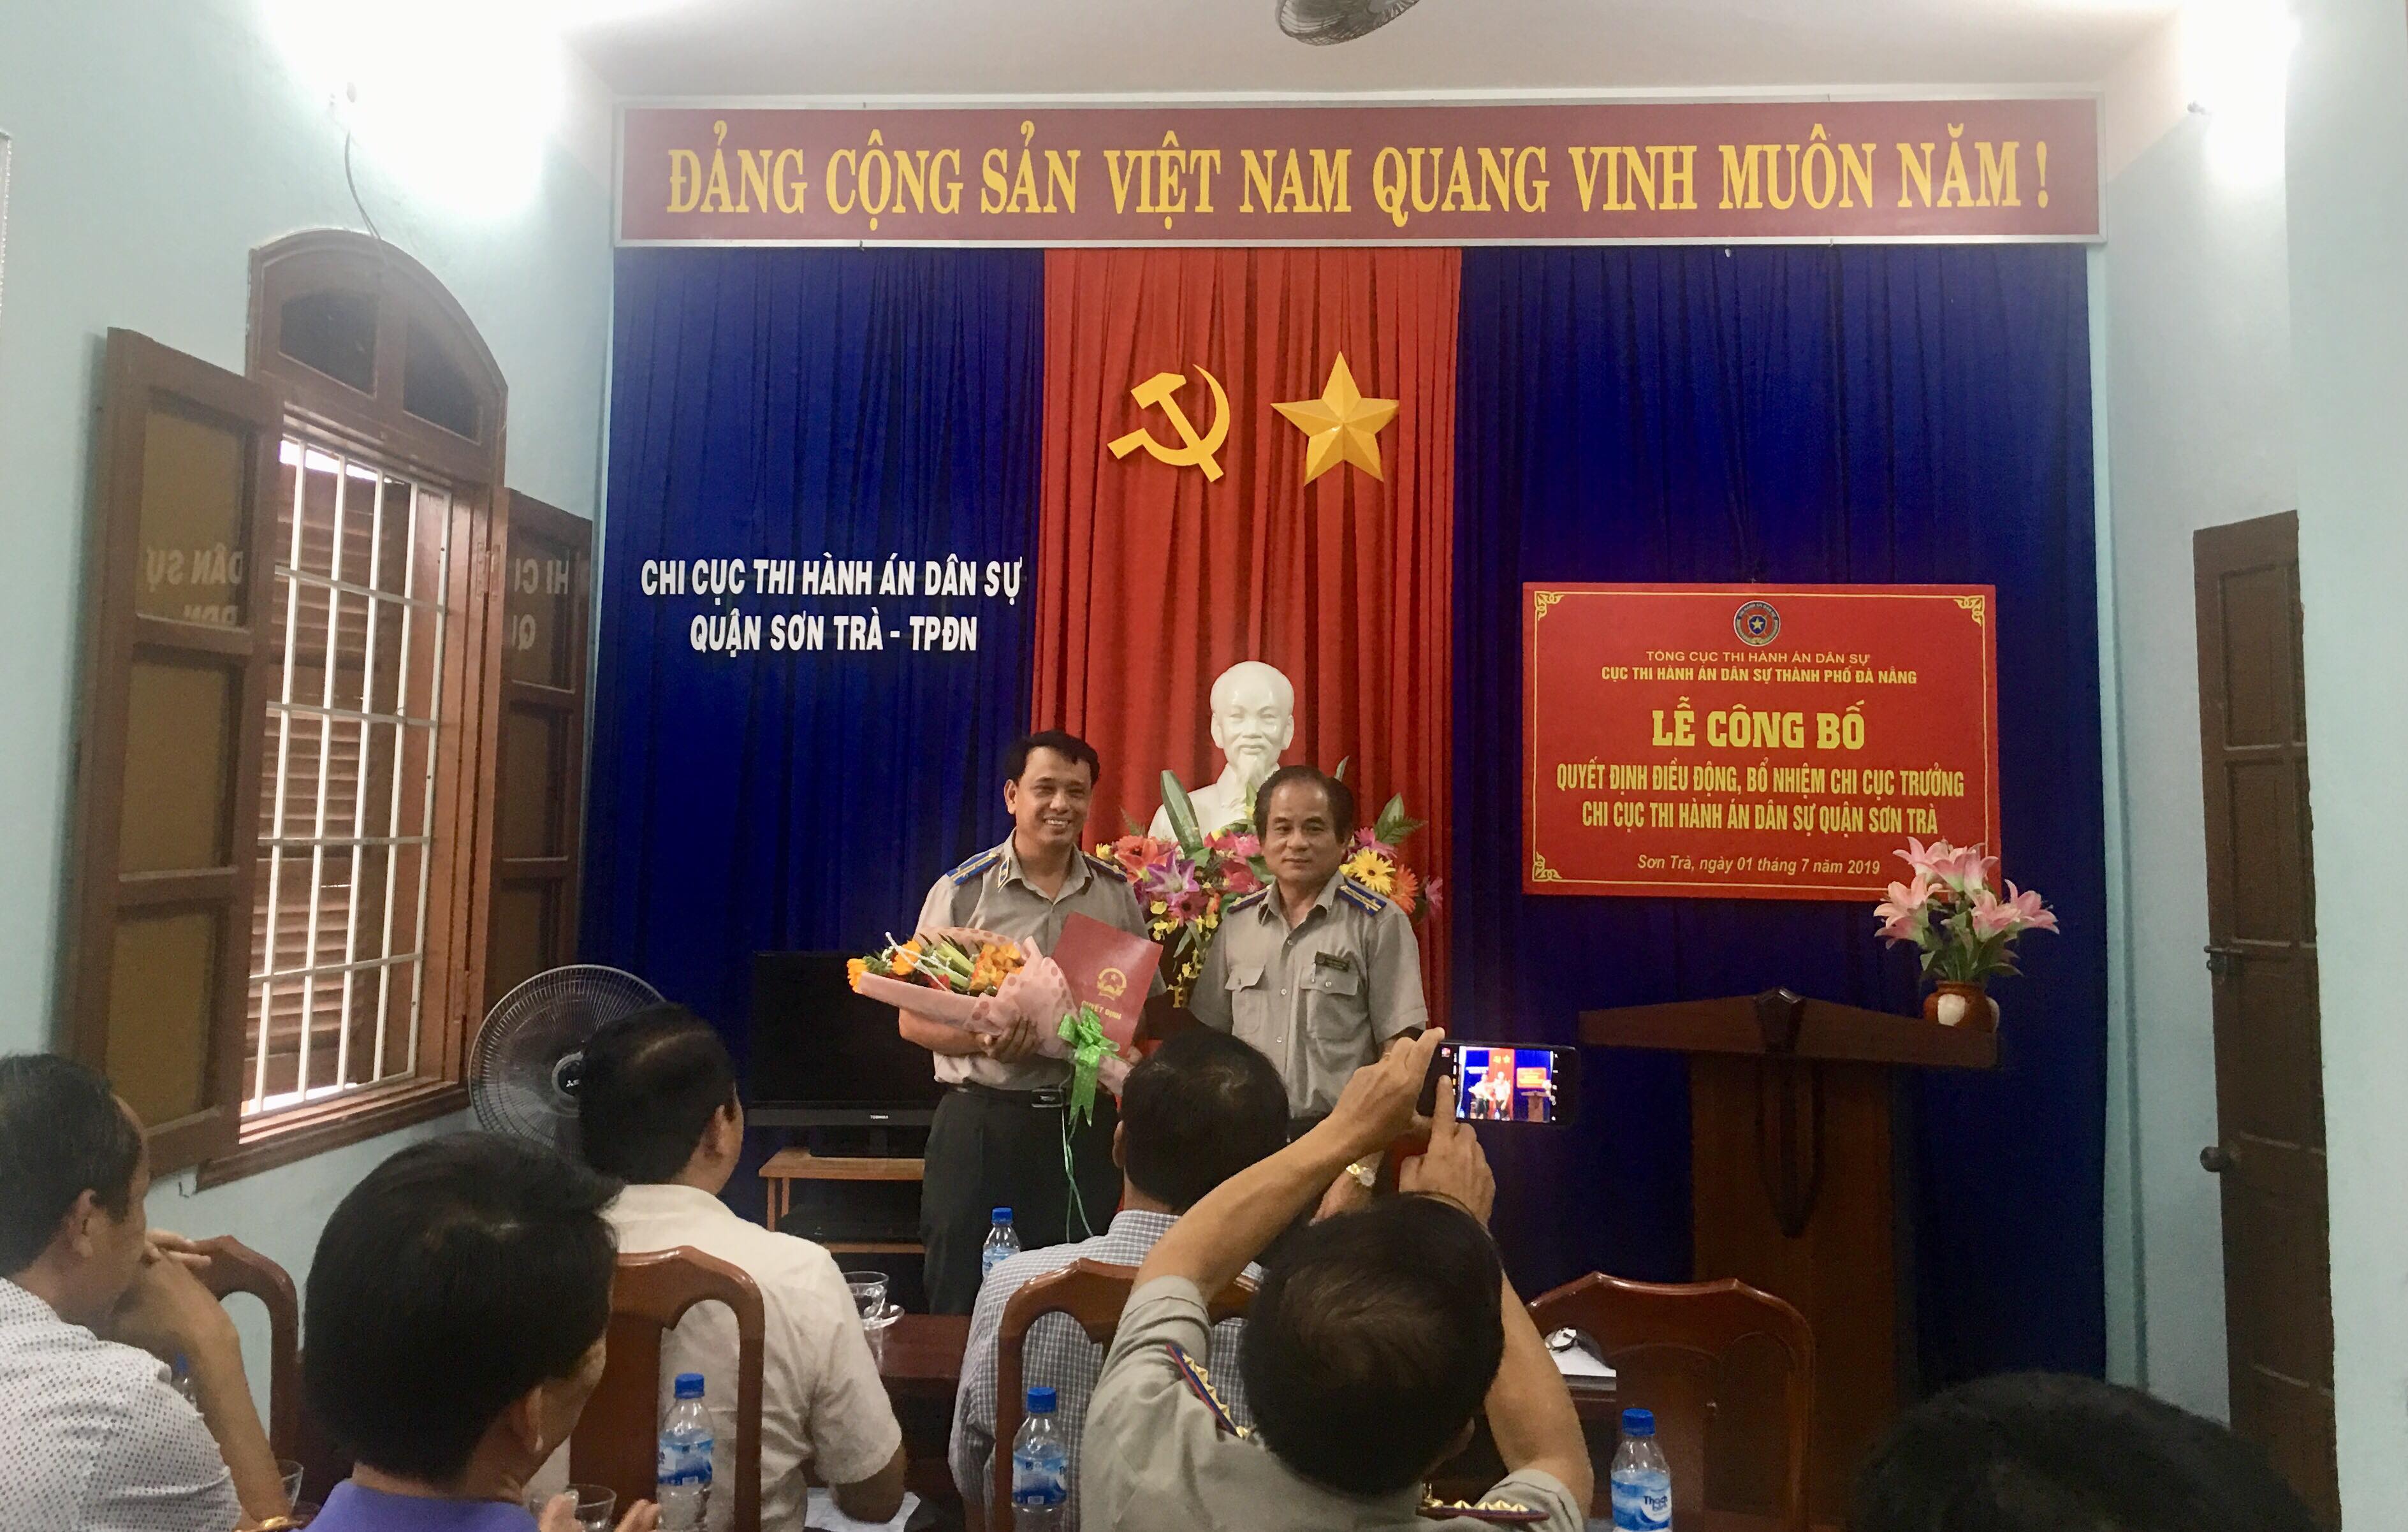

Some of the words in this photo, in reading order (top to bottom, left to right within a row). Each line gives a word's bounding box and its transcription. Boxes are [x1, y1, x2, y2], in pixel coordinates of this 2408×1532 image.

[668, 120, 806, 214] ĐẢNG
[826, 129, 964, 231] CỘNG
[981, 120, 1080, 214] SẢN
[1104, 130, 1221, 230] VIỆT
[1241, 148, 1352, 214] NAM
[1373, 146, 1550, 228] QUANG
[1568, 145, 1697, 211] VINH
[1719, 122, 1874, 210] MUÔN
[1897, 122, 2021, 208] NĂM
[2037, 141, 2049, 208] !
[641, 559, 685, 595] CHI
[692, 559, 745, 606] CỤC
[754, 559, 795, 595] THI
[802, 552, 872, 595] HÀNH
[879, 553, 915, 595] ÁN
[924, 553, 976, 596] DÂN
[984, 557, 1023, 606] SỰ
[690, 608, 761, 658] QUẬN
[770, 611, 824, 651] SƠN
[834, 607, 883, 651] TRÀ
[909, 616, 977, 651] TPĐN
[1602, 667, 1628, 682] CỤC
[1632, 667, 1653, 680] THI
[1658, 665, 1693, 680] HÀNH
[1698, 665, 1716, 680] ÁN
[1721, 666, 1748, 681] DÂN
[1753, 667, 1772, 685] SỰ
[1776, 666, 1820, 682] THÀNH
[1824, 666, 1851, 683] PHỐ
[1855, 668, 1874, 683] ĐÀ
[1689, 652, 1718, 664] CỤC
[1723, 652, 1744, 662] THI
[1749, 650, 1787, 662] HÀNH
[1791, 651, 1811, 663] ÁN
[1816, 652, 1844, 663] DÂN
[1850, 653, 1870, 666] SỰ
[1653, 696, 1695, 747] LỄ
[1707, 703, 1804, 748] CÔNG
[1817, 699, 1865, 750] BỐ
[1557, 756, 1605, 791] QUYẾT
[1610, 765, 1647, 795] ĐỊNH
[1653, 757, 1688, 791] ĐIỀU
[1693, 761, 1741, 796] ĐỘNG,
[1747, 757, 1769, 792] BỔ
[1773, 762, 1825, 799] NHIỆM
[1831, 769, 1857, 794] CHI
[1863, 770, 1895, 801] CỤC
[1899, 762, 1964, 797] TRƯỞNG
[1582, 801, 1608, 827] CHI
[1614, 801, 1644, 833] CỤC
[1649, 802, 1674, 828] THI
[1679, 798, 1722, 828] HÀNH
[1727, 798, 1749, 829] ÁN
[1755, 799, 1787, 830] DÂN
[1793, 803, 1816, 836] SỰ
[1820, 801, 1863, 838] QUẬN
[1869, 805, 1902, 833] SƠN
[1907, 803, 1938, 834] TRÀ
[1637, 854, 1665, 869] Sơn
[1670, 855, 1695, 872] Trà,
[1700, 856, 1733, 873] ngày
[1737, 857, 1752, 871] 01
[1758, 857, 1797, 875] tháng
[1802, 859, 1809, 872] 7
[1813, 859, 1842, 873] năm
[1848, 860, 1880, 875] 2019
